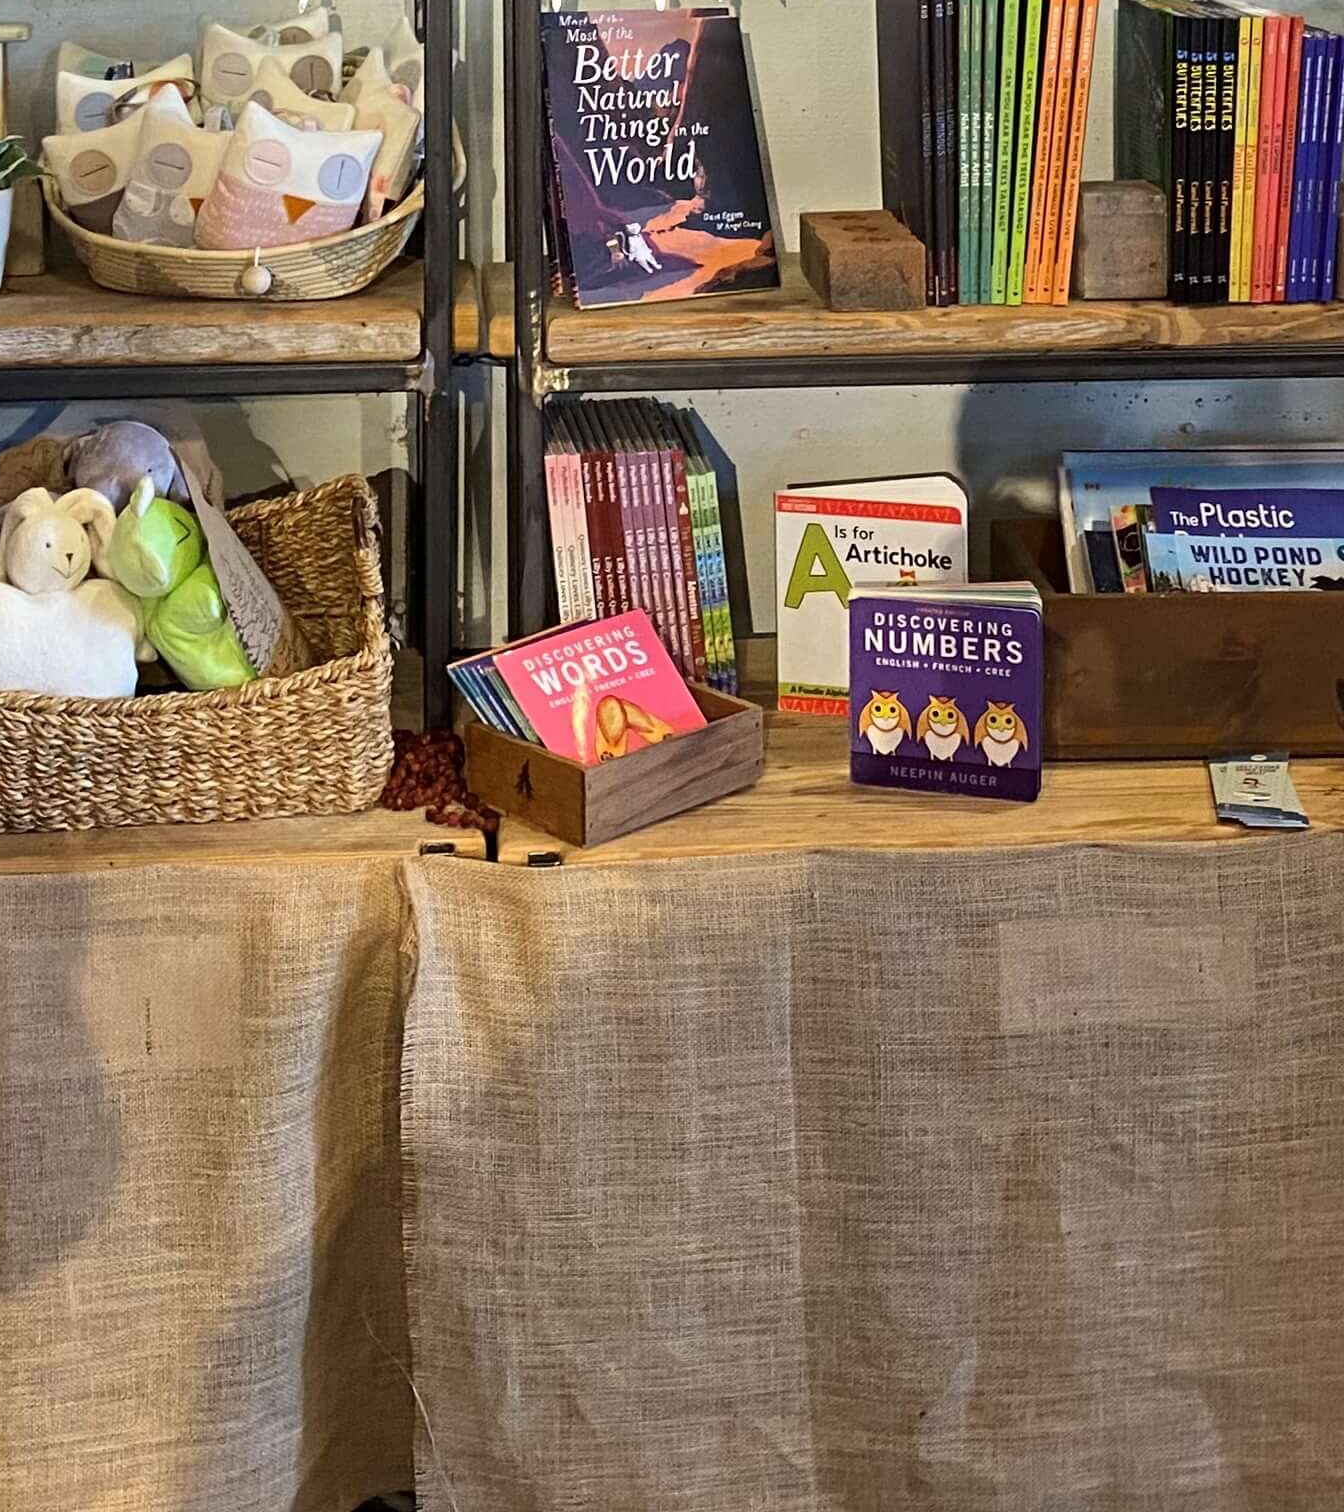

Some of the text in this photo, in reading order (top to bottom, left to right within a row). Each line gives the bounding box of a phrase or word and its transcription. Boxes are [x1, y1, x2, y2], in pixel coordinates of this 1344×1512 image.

[565, 27, 634, 44] Most of the
[572, 45, 680, 85] Better
[1024, 70, 1033, 89] CAN
[577, 81, 681, 113] Natural
[1023, 91, 1032, 111] YOU
[1175, 62, 1187, 128] BUTTERFLIES
[580, 114, 709, 146] Things in the
[1021, 115, 1031, 139] HEAR
[584, 140, 697, 187] World
[1020, 142, 1030, 159] THE
[1018, 162, 1028, 189] TREES
[1169, 503, 1295, 529] The Plastic
[784, 523, 874, 609] A Is for
[845, 543, 953, 570] Artichoke
[1190, 545, 1322, 566] WILD POND
[1209, 567, 1305, 587] HOCKEY
[874, 612, 1013, 636] DISCOVERING
[522, 626, 636, 671] DISCOVERING
[864, 628, 1023, 664] NUMBERS
[530, 640, 649, 697] WORDS
[635, 667, 656, 680] CREE
[876, 657, 1011, 677] ENGLISH FRENCH CREE
[890, 766, 997, 787] NEEPIN AUGER
